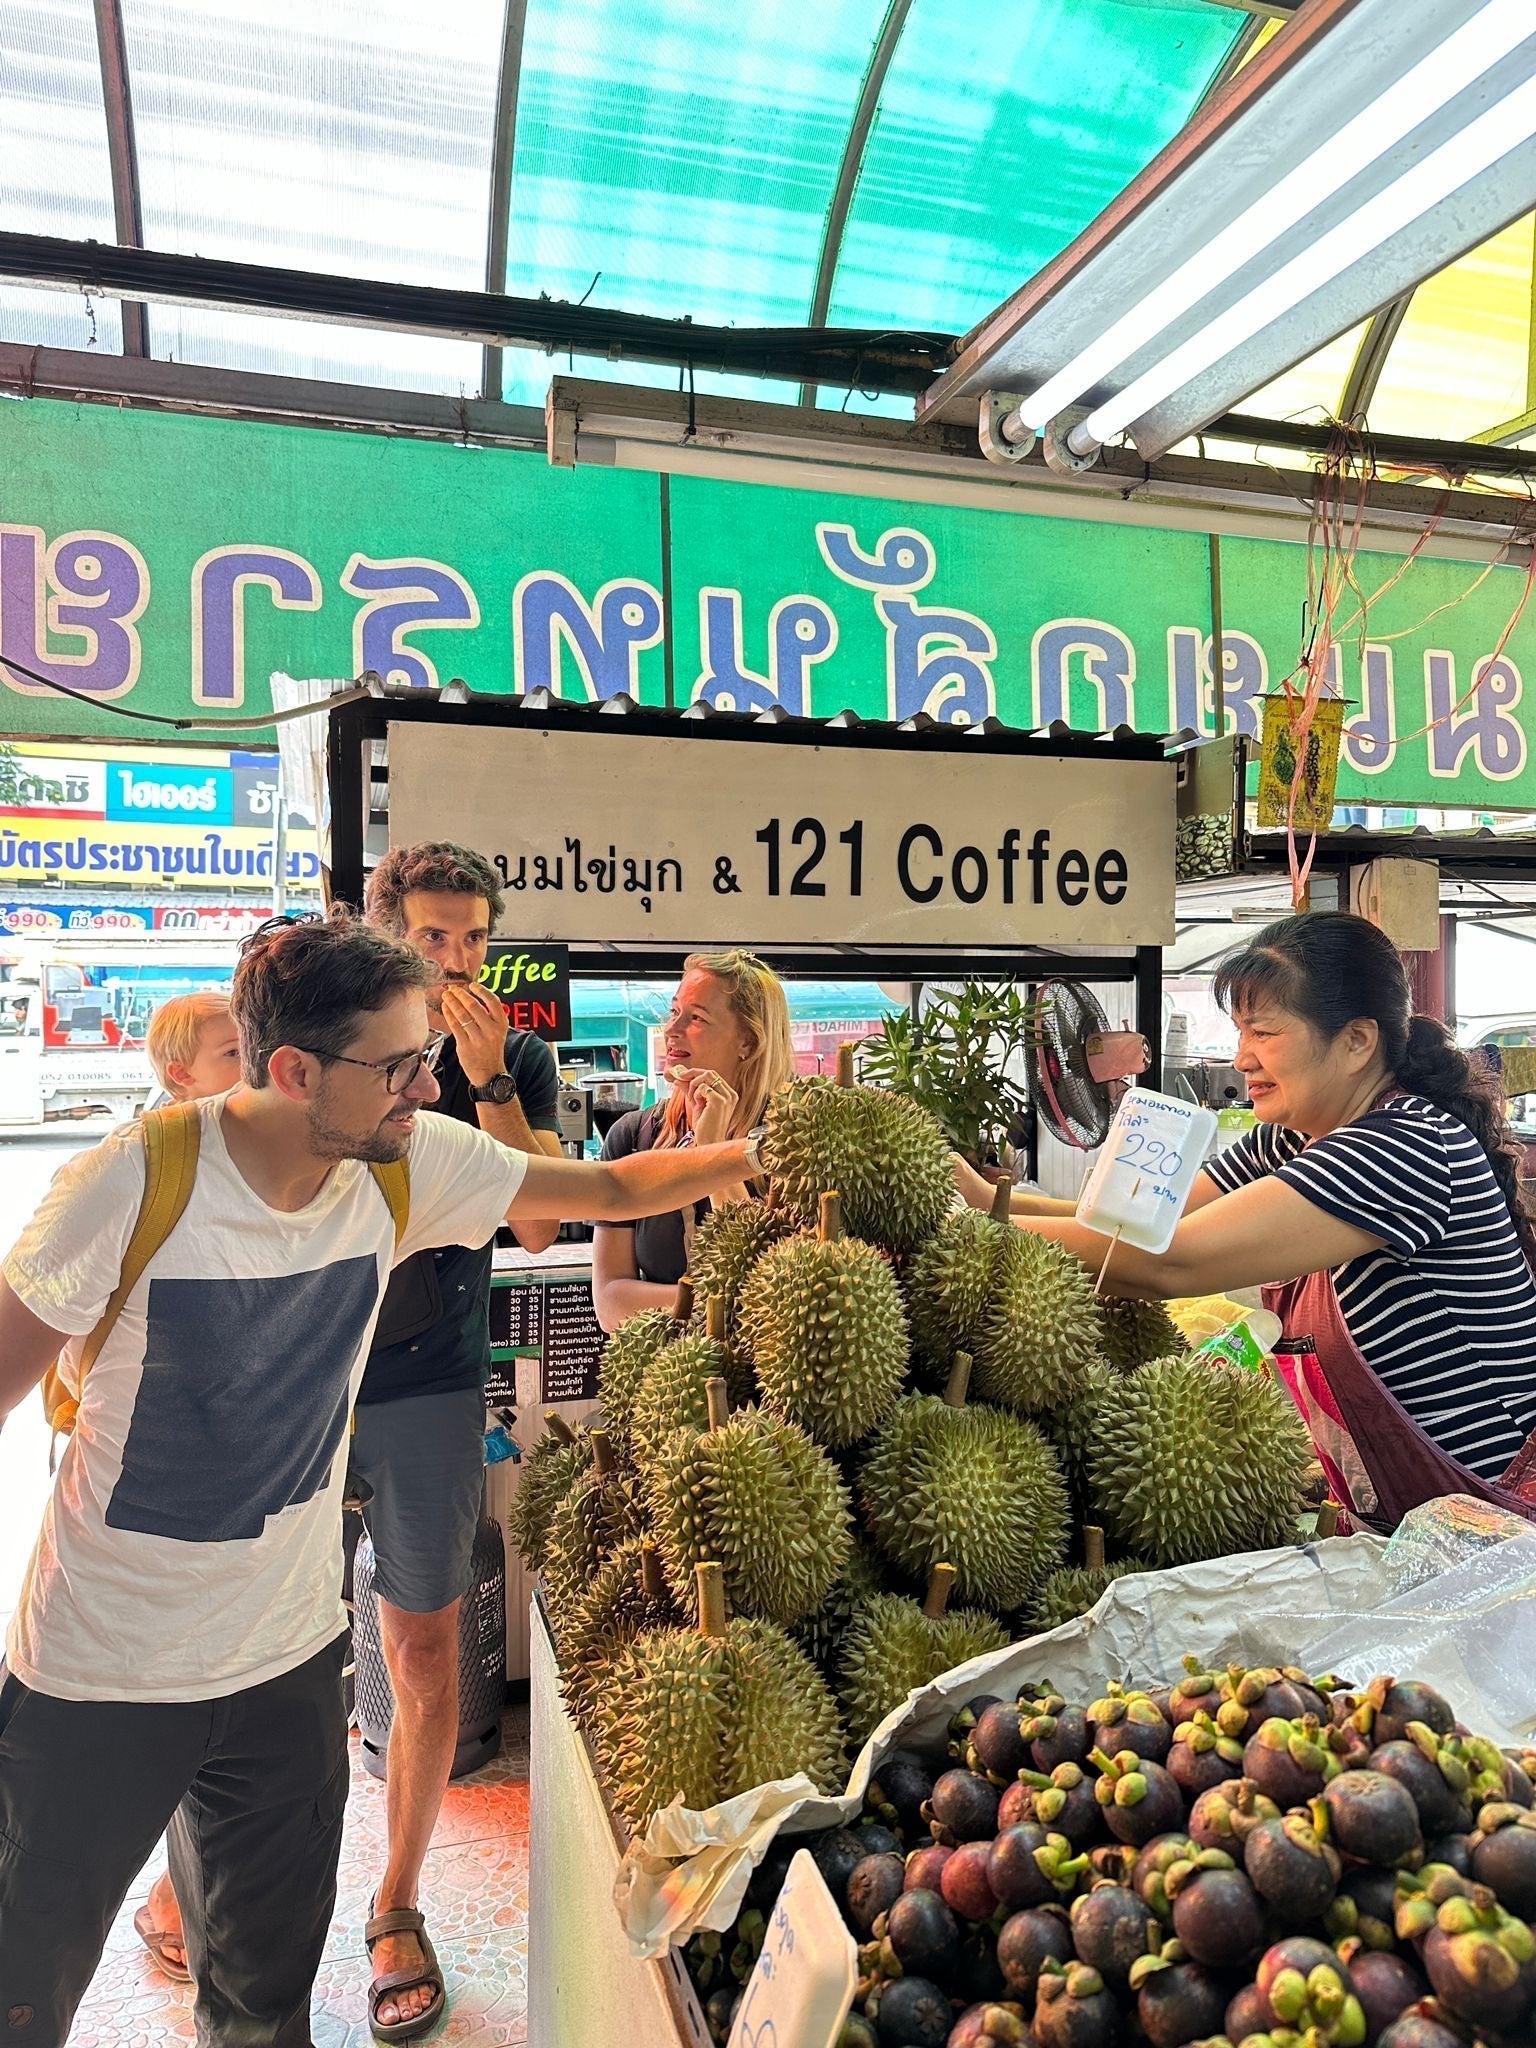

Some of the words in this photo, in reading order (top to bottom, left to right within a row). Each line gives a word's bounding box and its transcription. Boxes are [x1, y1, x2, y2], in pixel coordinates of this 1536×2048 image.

[118, 770, 217, 812] ไฮเออร์
[480, 837, 682, 913] นมไข่มุก
[713, 855, 742, 894] &
[755, 817, 863, 897] 121
[897, 823, 1128, 906] Coffee
[1115, 1133, 1183, 1177] 220
